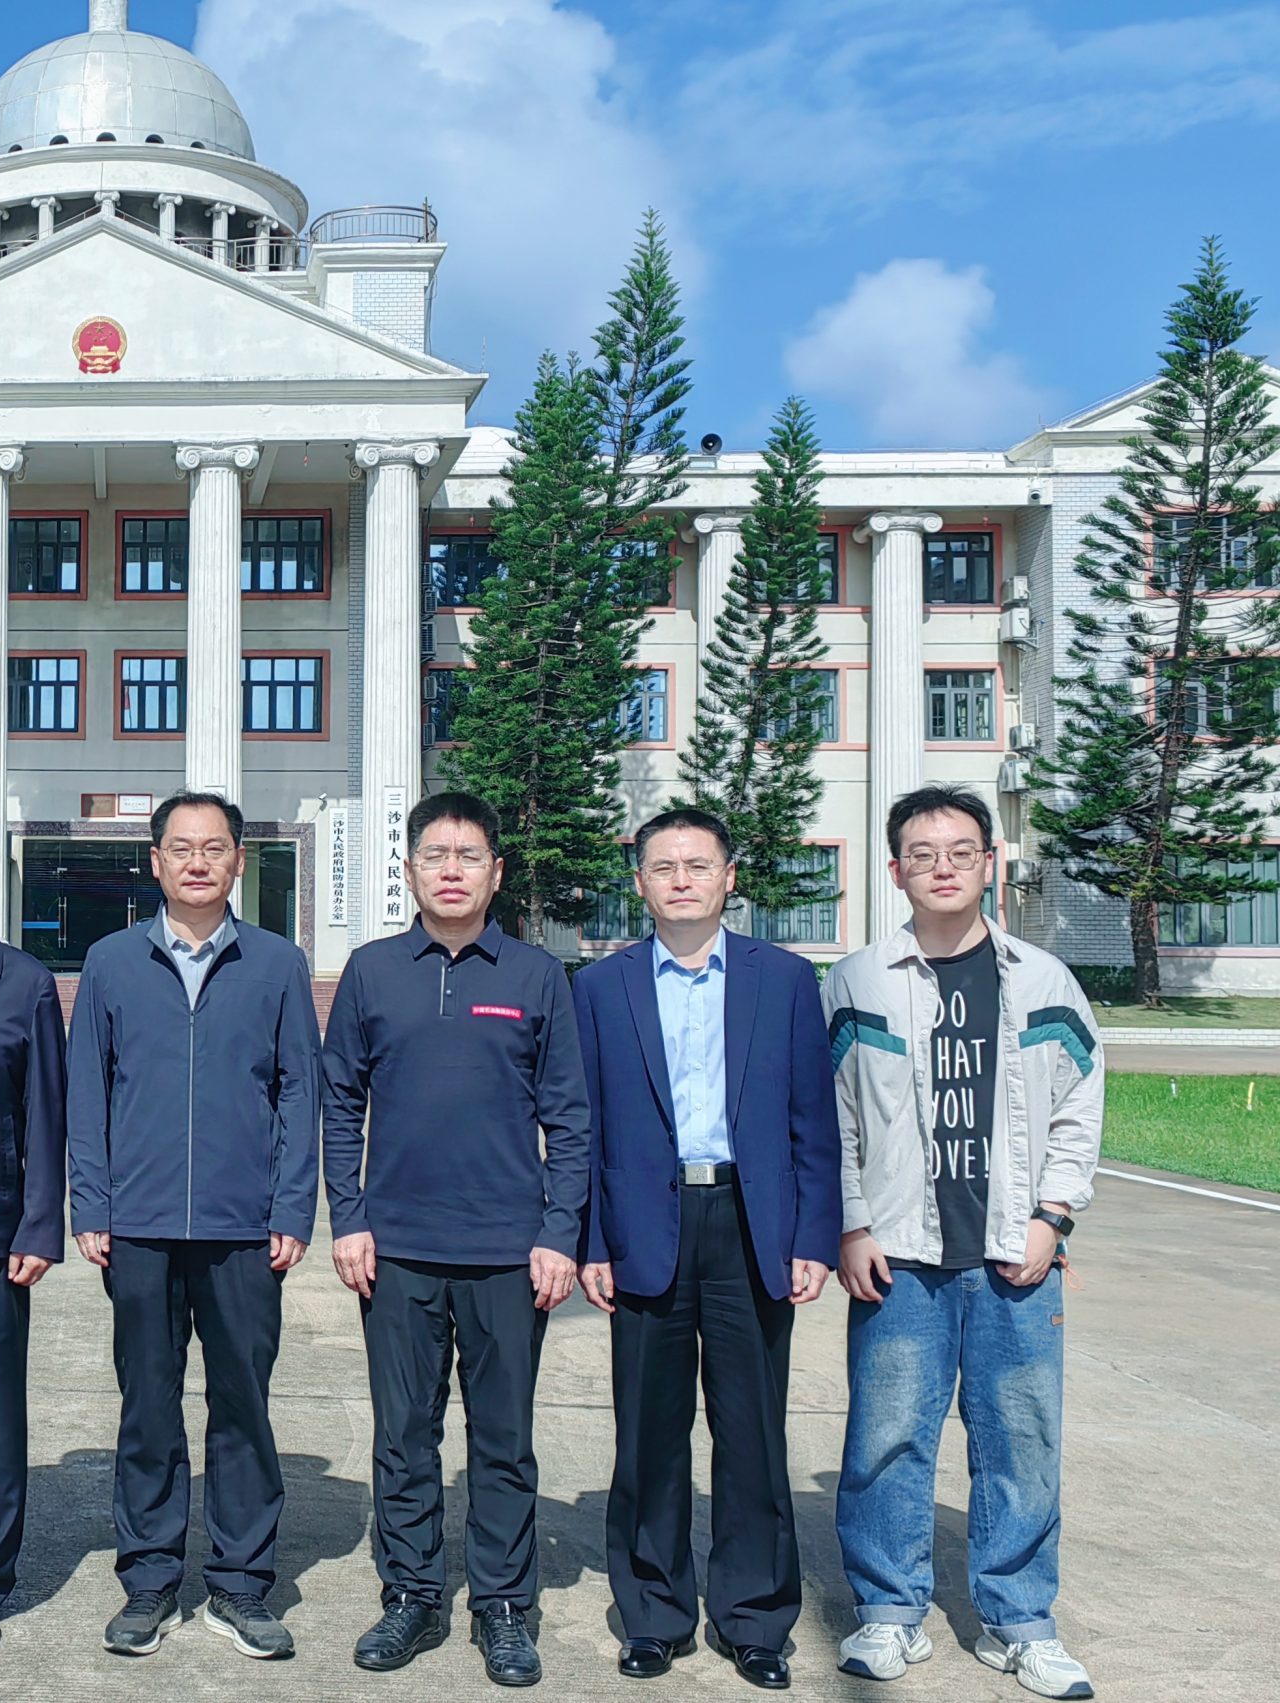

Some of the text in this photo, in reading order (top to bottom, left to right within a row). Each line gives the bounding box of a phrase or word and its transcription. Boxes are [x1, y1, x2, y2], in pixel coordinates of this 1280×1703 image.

[332, 813, 344, 920] 三沙市人民政府国防动员办公室
[387, 794, 401, 916] 三沙市人民政府
[937, 1036, 987, 1080] HAT
[932, 1136, 991, 1180] OVE!
